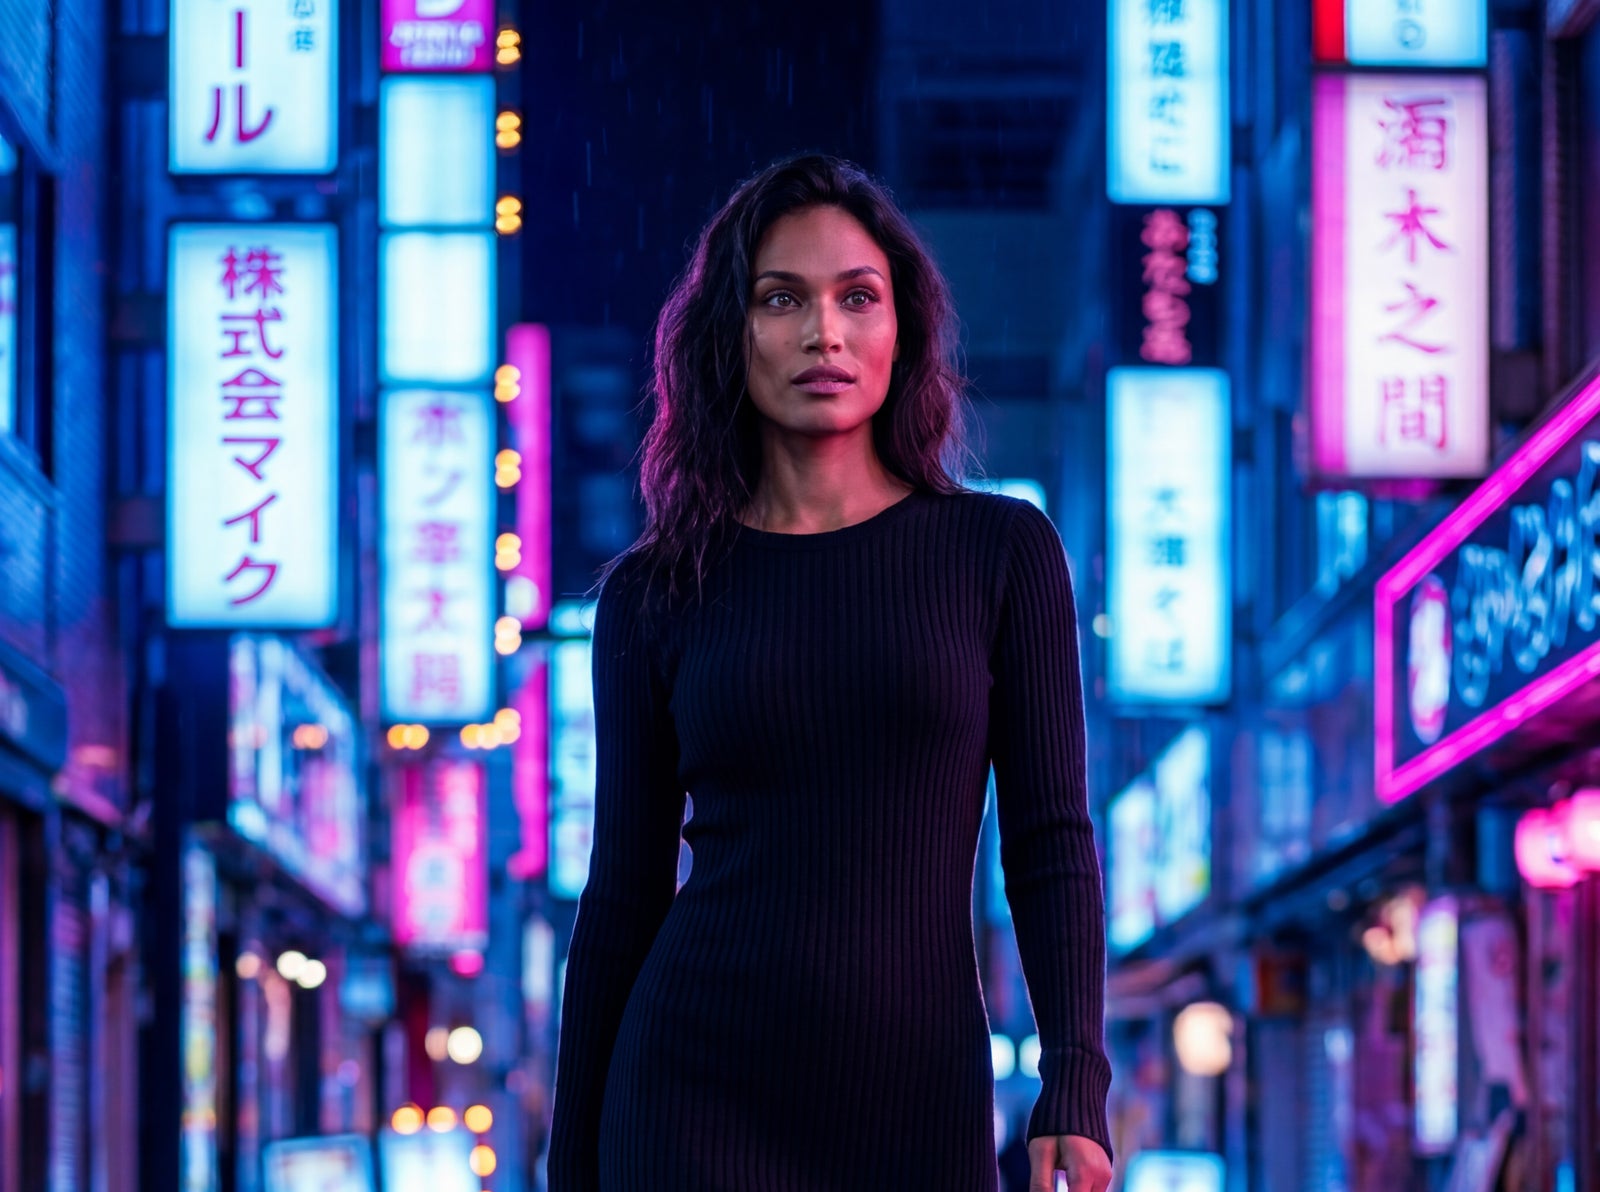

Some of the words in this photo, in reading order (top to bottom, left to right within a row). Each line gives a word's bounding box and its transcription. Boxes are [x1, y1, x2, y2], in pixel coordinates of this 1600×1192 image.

[220, 246, 284, 606] 株式会マイク
